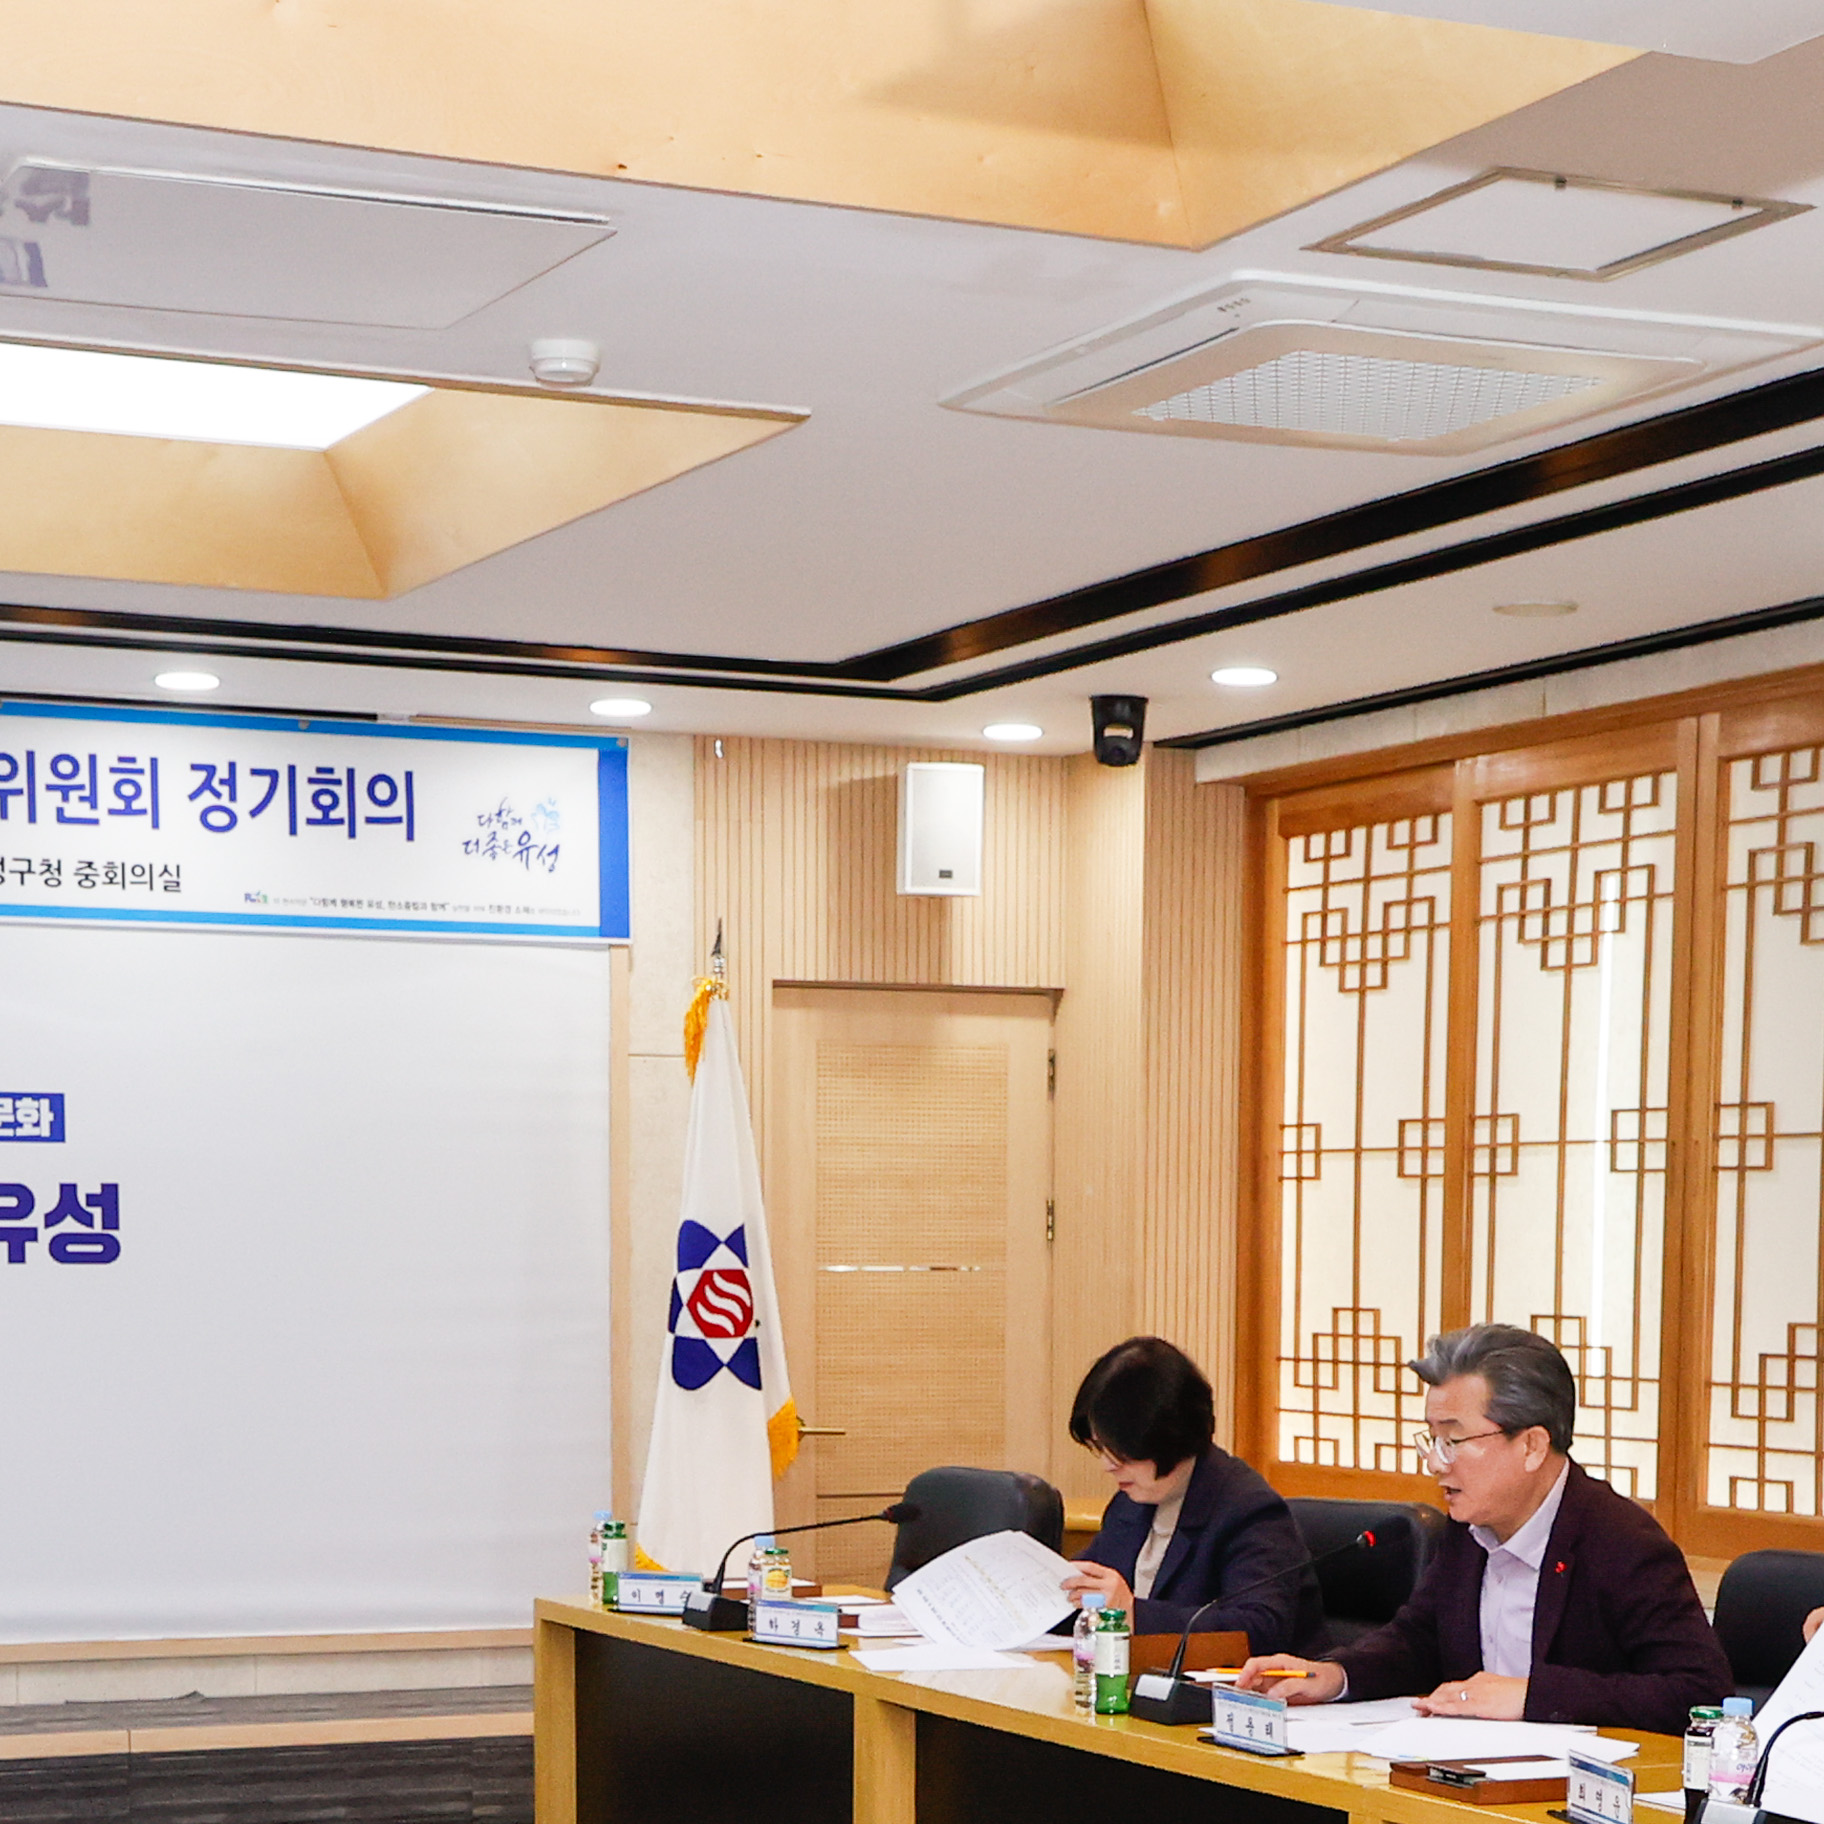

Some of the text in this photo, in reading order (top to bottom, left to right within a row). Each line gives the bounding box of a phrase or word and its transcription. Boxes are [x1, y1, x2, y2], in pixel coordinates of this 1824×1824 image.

[188, 755, 416, 842] 정기회의
[513, 830, 560, 873] 유성
[74, 861, 182, 893] 중회의실
